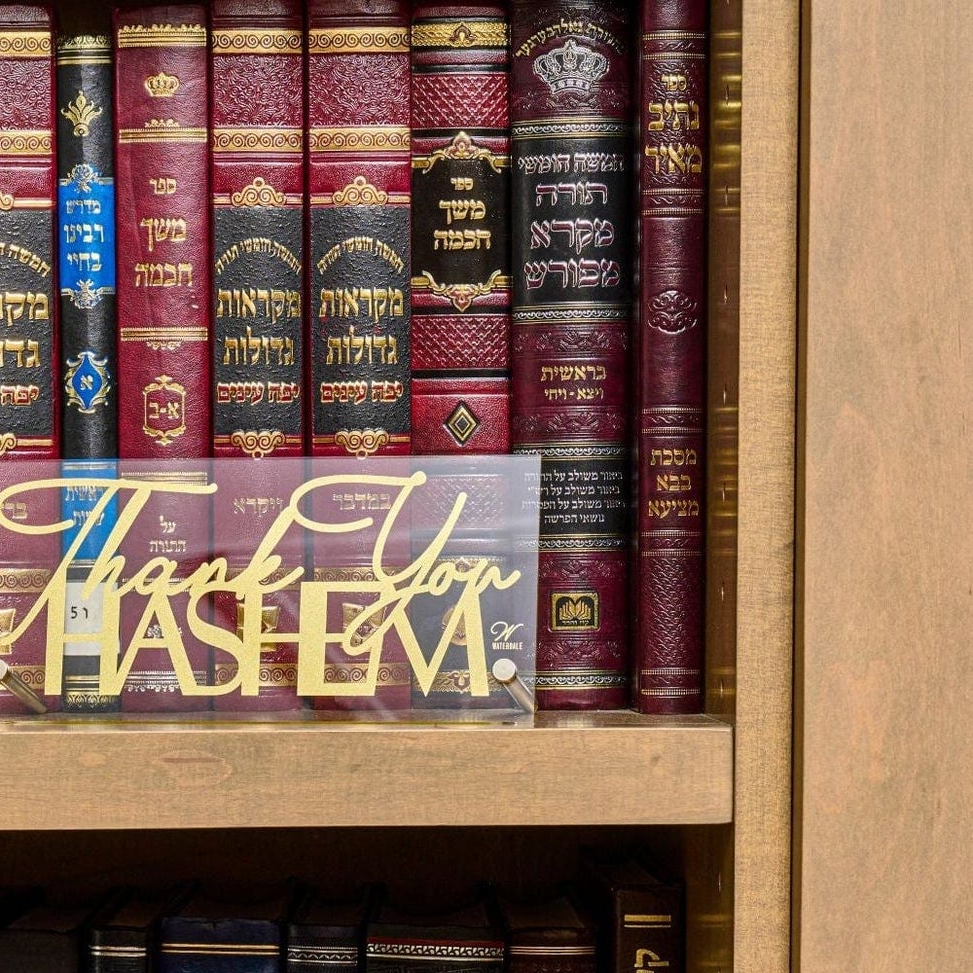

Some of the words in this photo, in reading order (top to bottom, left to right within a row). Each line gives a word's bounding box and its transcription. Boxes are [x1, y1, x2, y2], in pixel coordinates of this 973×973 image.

[661, 73, 687, 91] ספר
[518, 153, 570, 175] חומשי
[644, 142, 702, 174] מאיר
[150, 177, 177, 195] ספר
[450, 177, 474, 191] ספר
[536, 181, 608, 206] תורה
[439, 200, 486, 225] משך
[64, 224, 104, 243] רבינו
[140, 218, 187, 252] משך
[434, 229, 491, 251] חכמה
[530, 218, 615, 254] מקרא
[8, 243, 51, 278] חמשה
[66, 252, 102, 272] בחיי
[135, 262, 193, 287] חכמה
[523, 258, 621, 289] מפורש
[216, 288, 301, 323] מקראות
[319, 287, 404, 323] מקראות
[224, 326, 294, 365] גדולות
[327, 325, 400, 364] גדולות
[80, 375, 93, 390] א
[540, 364, 607, 383] בראשית
[0, 385, 39, 405] יפה
[217, 381, 265, 405] עינים
[268, 382, 300, 402] יפה
[321, 381, 367, 405] עינים
[372, 382, 404, 402] יפה
[148, 401, 180, 420] א-ב
[650, 447, 697, 466] מסכת
[554, 470, 566, 482] על
[568, 469, 598, 482] משולב
[656, 474, 691, 492] בבא
[550, 484, 563, 496] על
[565, 484, 595, 495] משולב
[558, 498, 570, 510] על
[572, 498, 602, 509] משולב
[648, 500, 699, 520] מציעא
[160, 515, 176, 534] על
[544, 513, 578, 524] הפרשה
[149, 540, 186, 552] התורה
[290, 472, 520, 649] You
[45, 580, 490, 697] HASHEM
